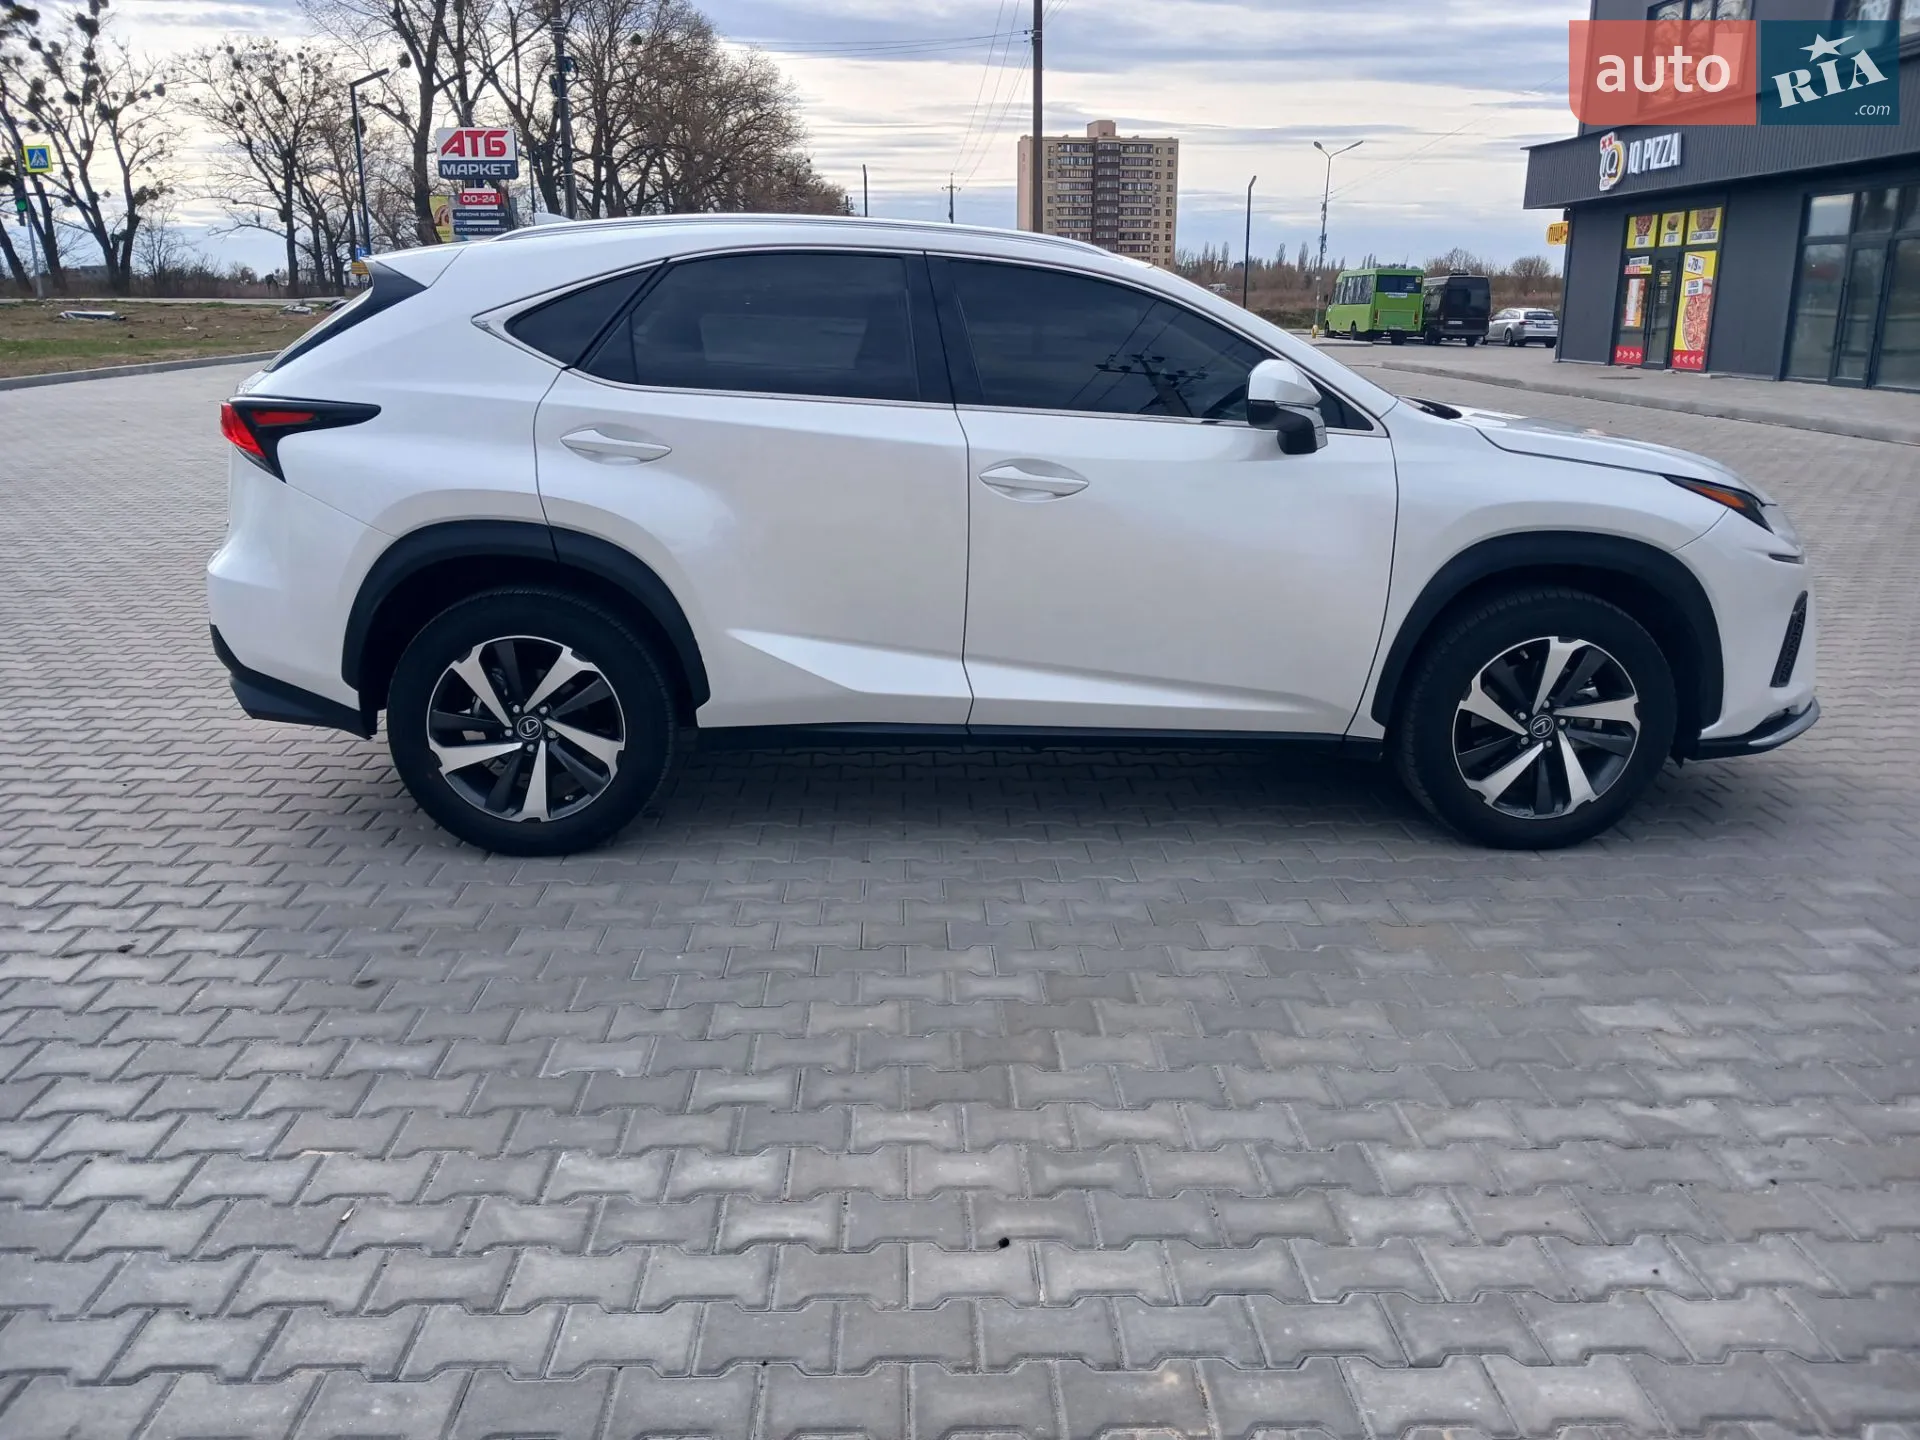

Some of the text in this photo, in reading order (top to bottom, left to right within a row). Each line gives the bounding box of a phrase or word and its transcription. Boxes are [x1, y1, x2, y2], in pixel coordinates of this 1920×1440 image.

[441, 130, 508, 157] АТБ
[1627, 132, 1681, 174] IQ PIZZA
[442, 163, 511, 176] МАРКЕТ
[462, 195, 496, 203] 00-24
